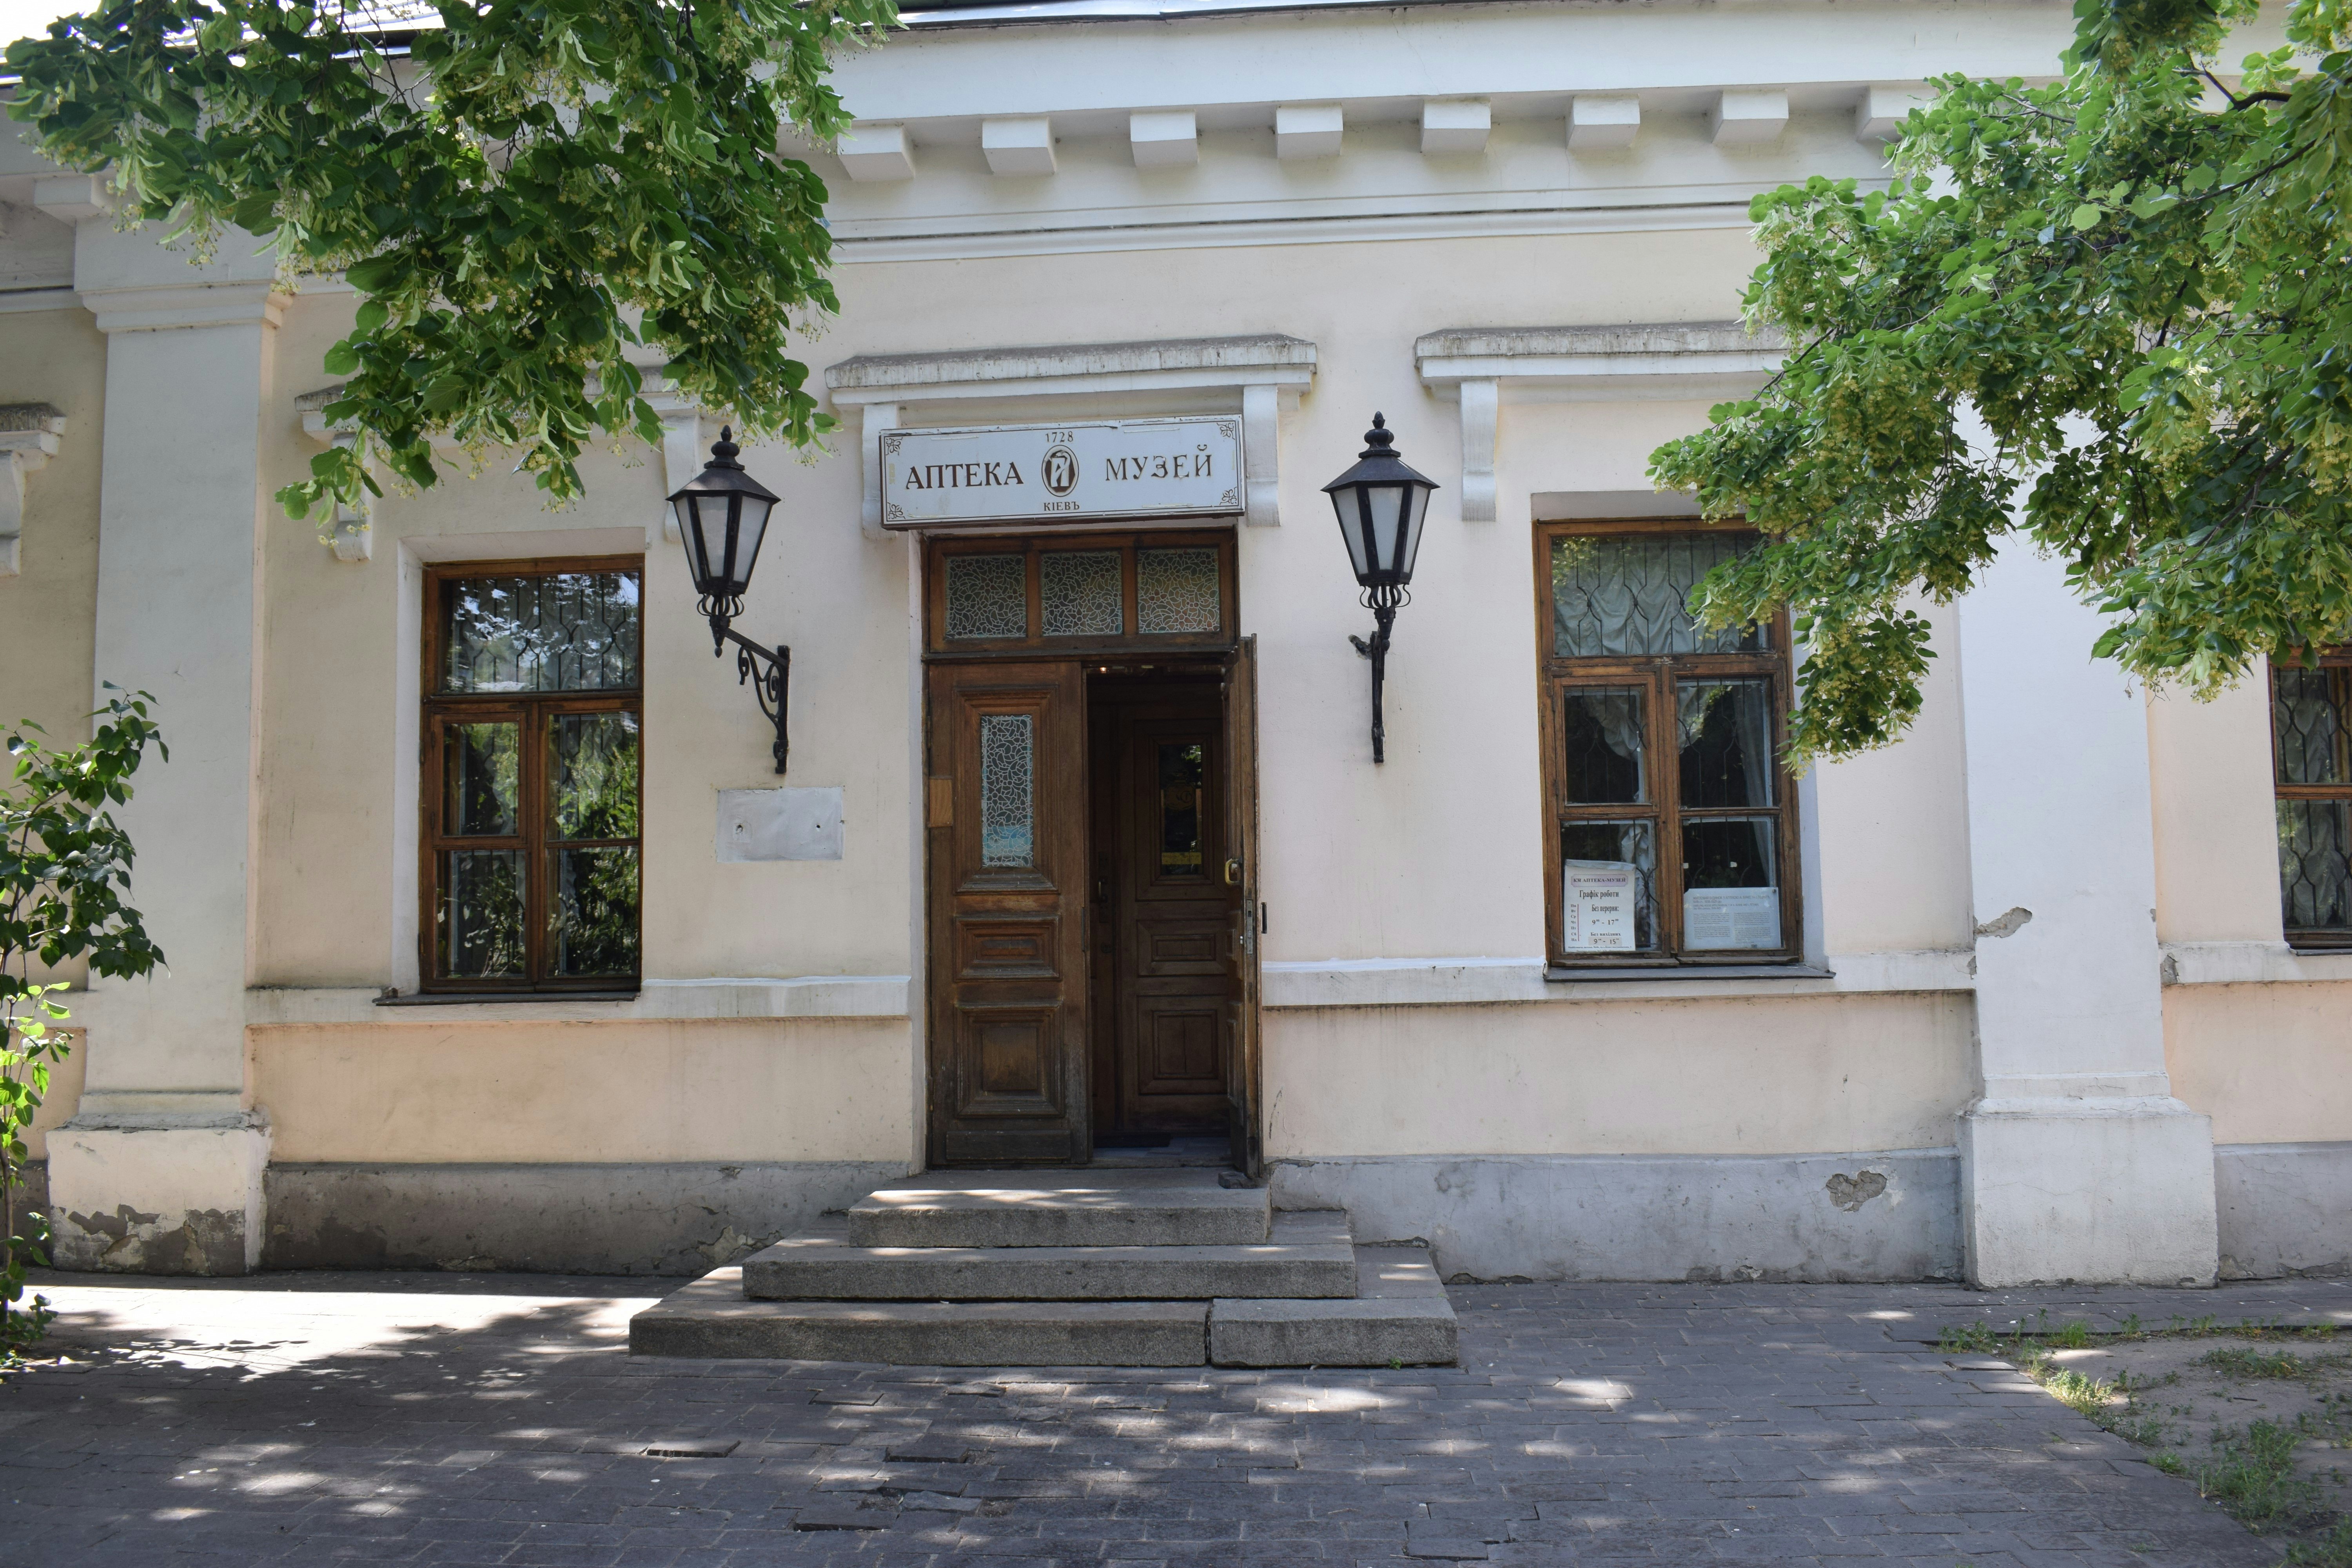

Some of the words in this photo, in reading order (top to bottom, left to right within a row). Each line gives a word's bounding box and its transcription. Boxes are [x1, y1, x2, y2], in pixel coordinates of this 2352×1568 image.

[1045, 431, 1073, 443] 1728
[906, 461, 1024, 490] АПТЕКА
[1105, 444, 1212, 481] МУЗЕЙ
[1579, 890, 1599, 899] Графік
[1600, 890, 1619, 899] роботи
